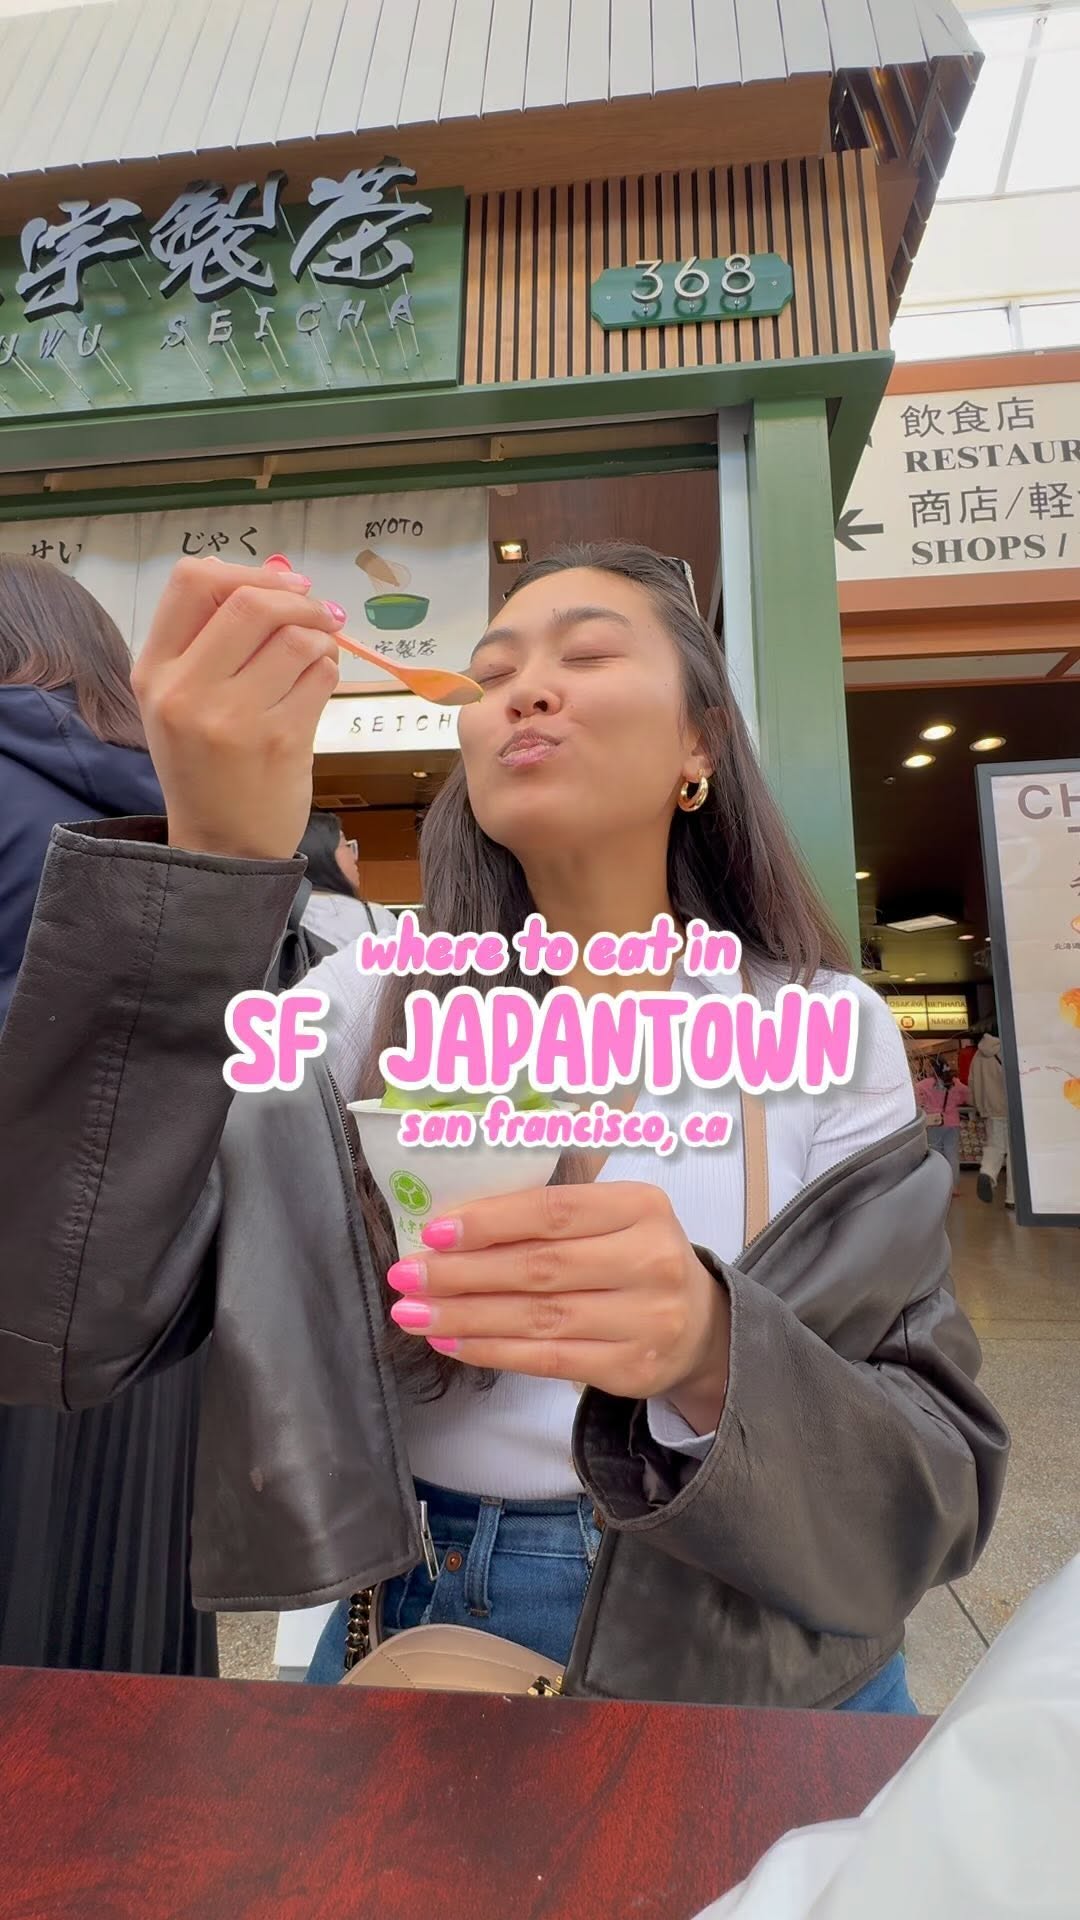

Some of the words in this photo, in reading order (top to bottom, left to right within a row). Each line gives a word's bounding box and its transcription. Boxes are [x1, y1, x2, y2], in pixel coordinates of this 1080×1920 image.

[631, 253, 756, 303] 368
[160, 294, 416, 350] SEICHA
[900, 396, 1035, 438] 飲食店
[903, 439, 1080, 473] RESTAUR
[908, 481, 1080, 528] 商店/軽
[181, 526, 258, 556] じゃく
[365, 516, 424, 539] KYOTO
[911, 534, 1046, 566] SHOPS
[350, 713, 452, 734] SEICH
